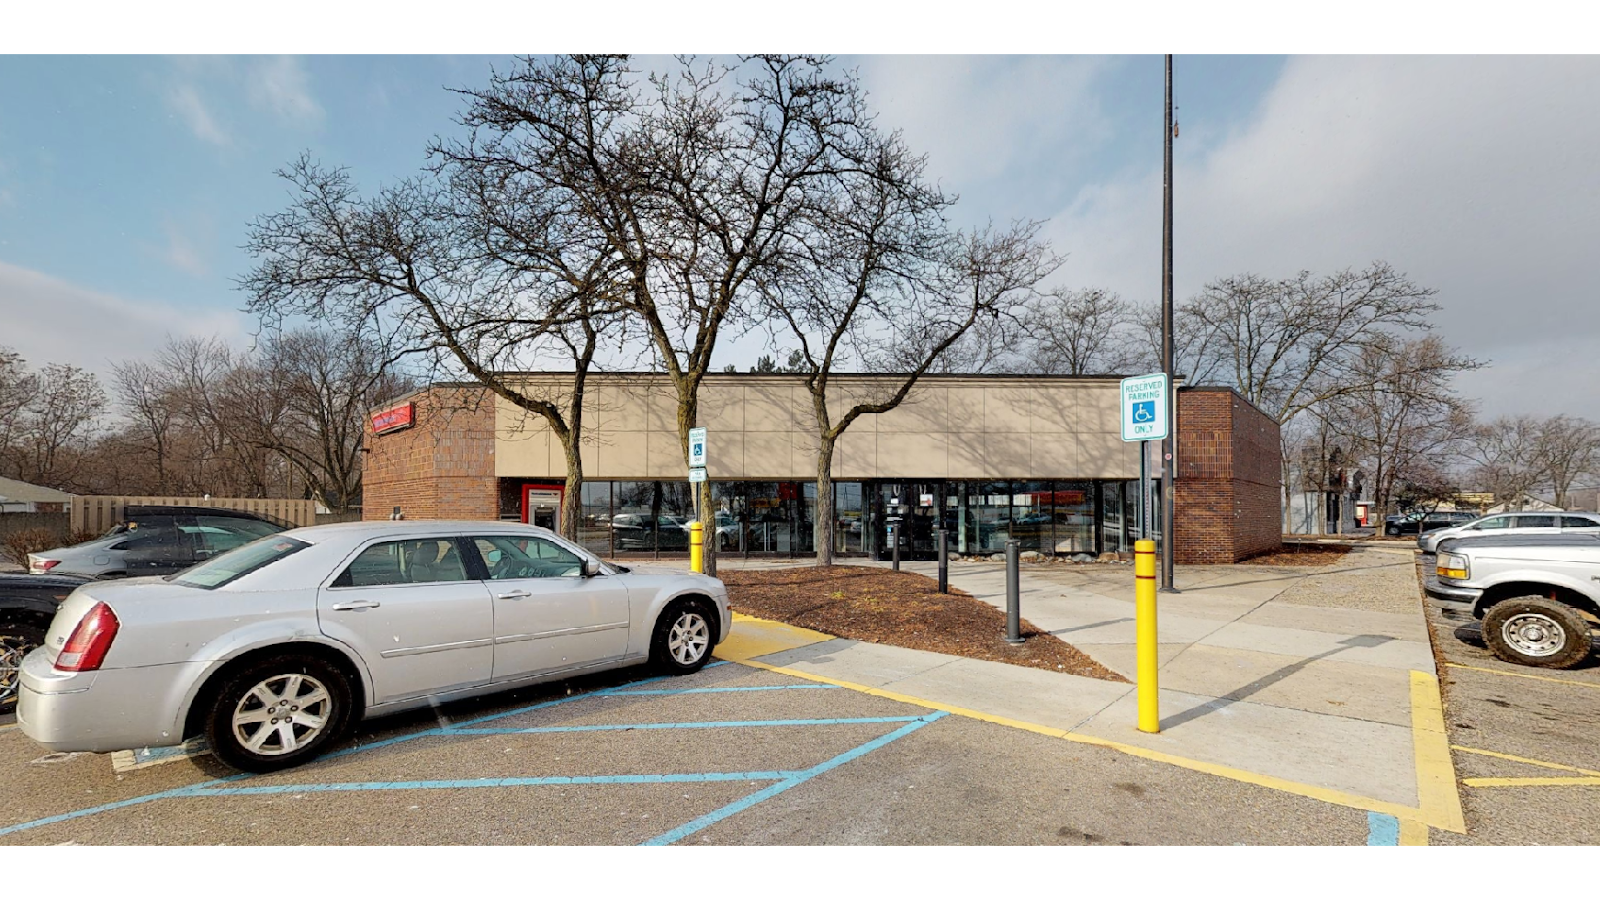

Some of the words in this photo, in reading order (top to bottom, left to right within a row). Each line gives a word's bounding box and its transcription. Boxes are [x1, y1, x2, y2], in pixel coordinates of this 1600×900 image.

[1125, 380, 1163, 393] RESERVED
[1128, 390, 1160, 401] PARKING
[1134, 424, 1154, 434] ONLY
